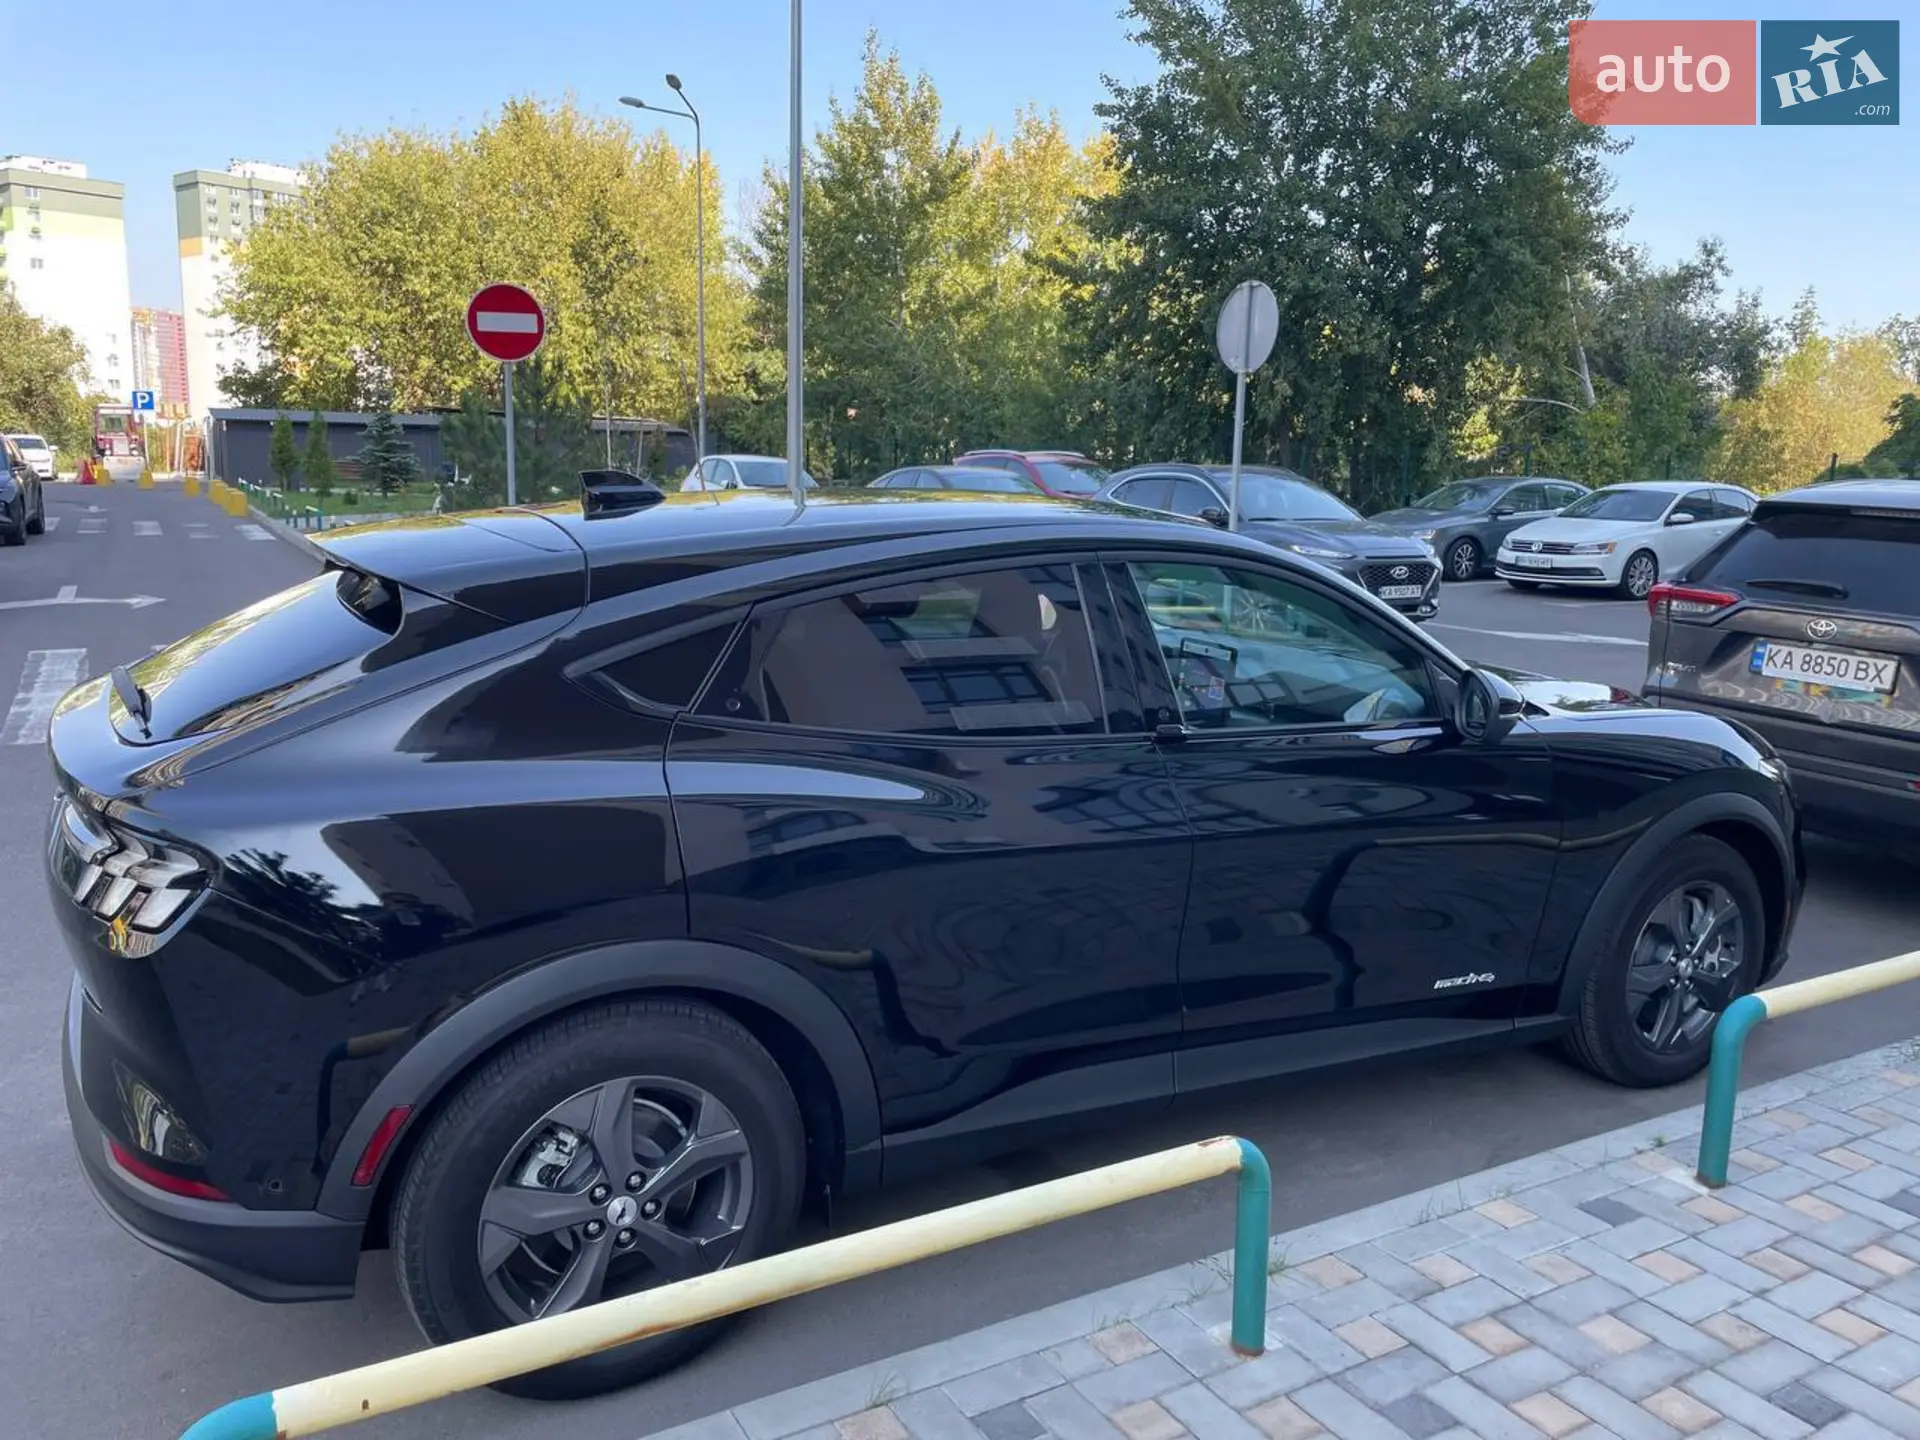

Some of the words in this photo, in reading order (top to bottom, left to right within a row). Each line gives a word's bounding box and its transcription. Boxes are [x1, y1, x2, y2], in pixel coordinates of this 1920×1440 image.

[137, 392, 150, 409] P
[1766, 647, 1794, 671] KA
[1800, 653, 1850, 678] 8850
[1854, 660, 1889, 685] BX
